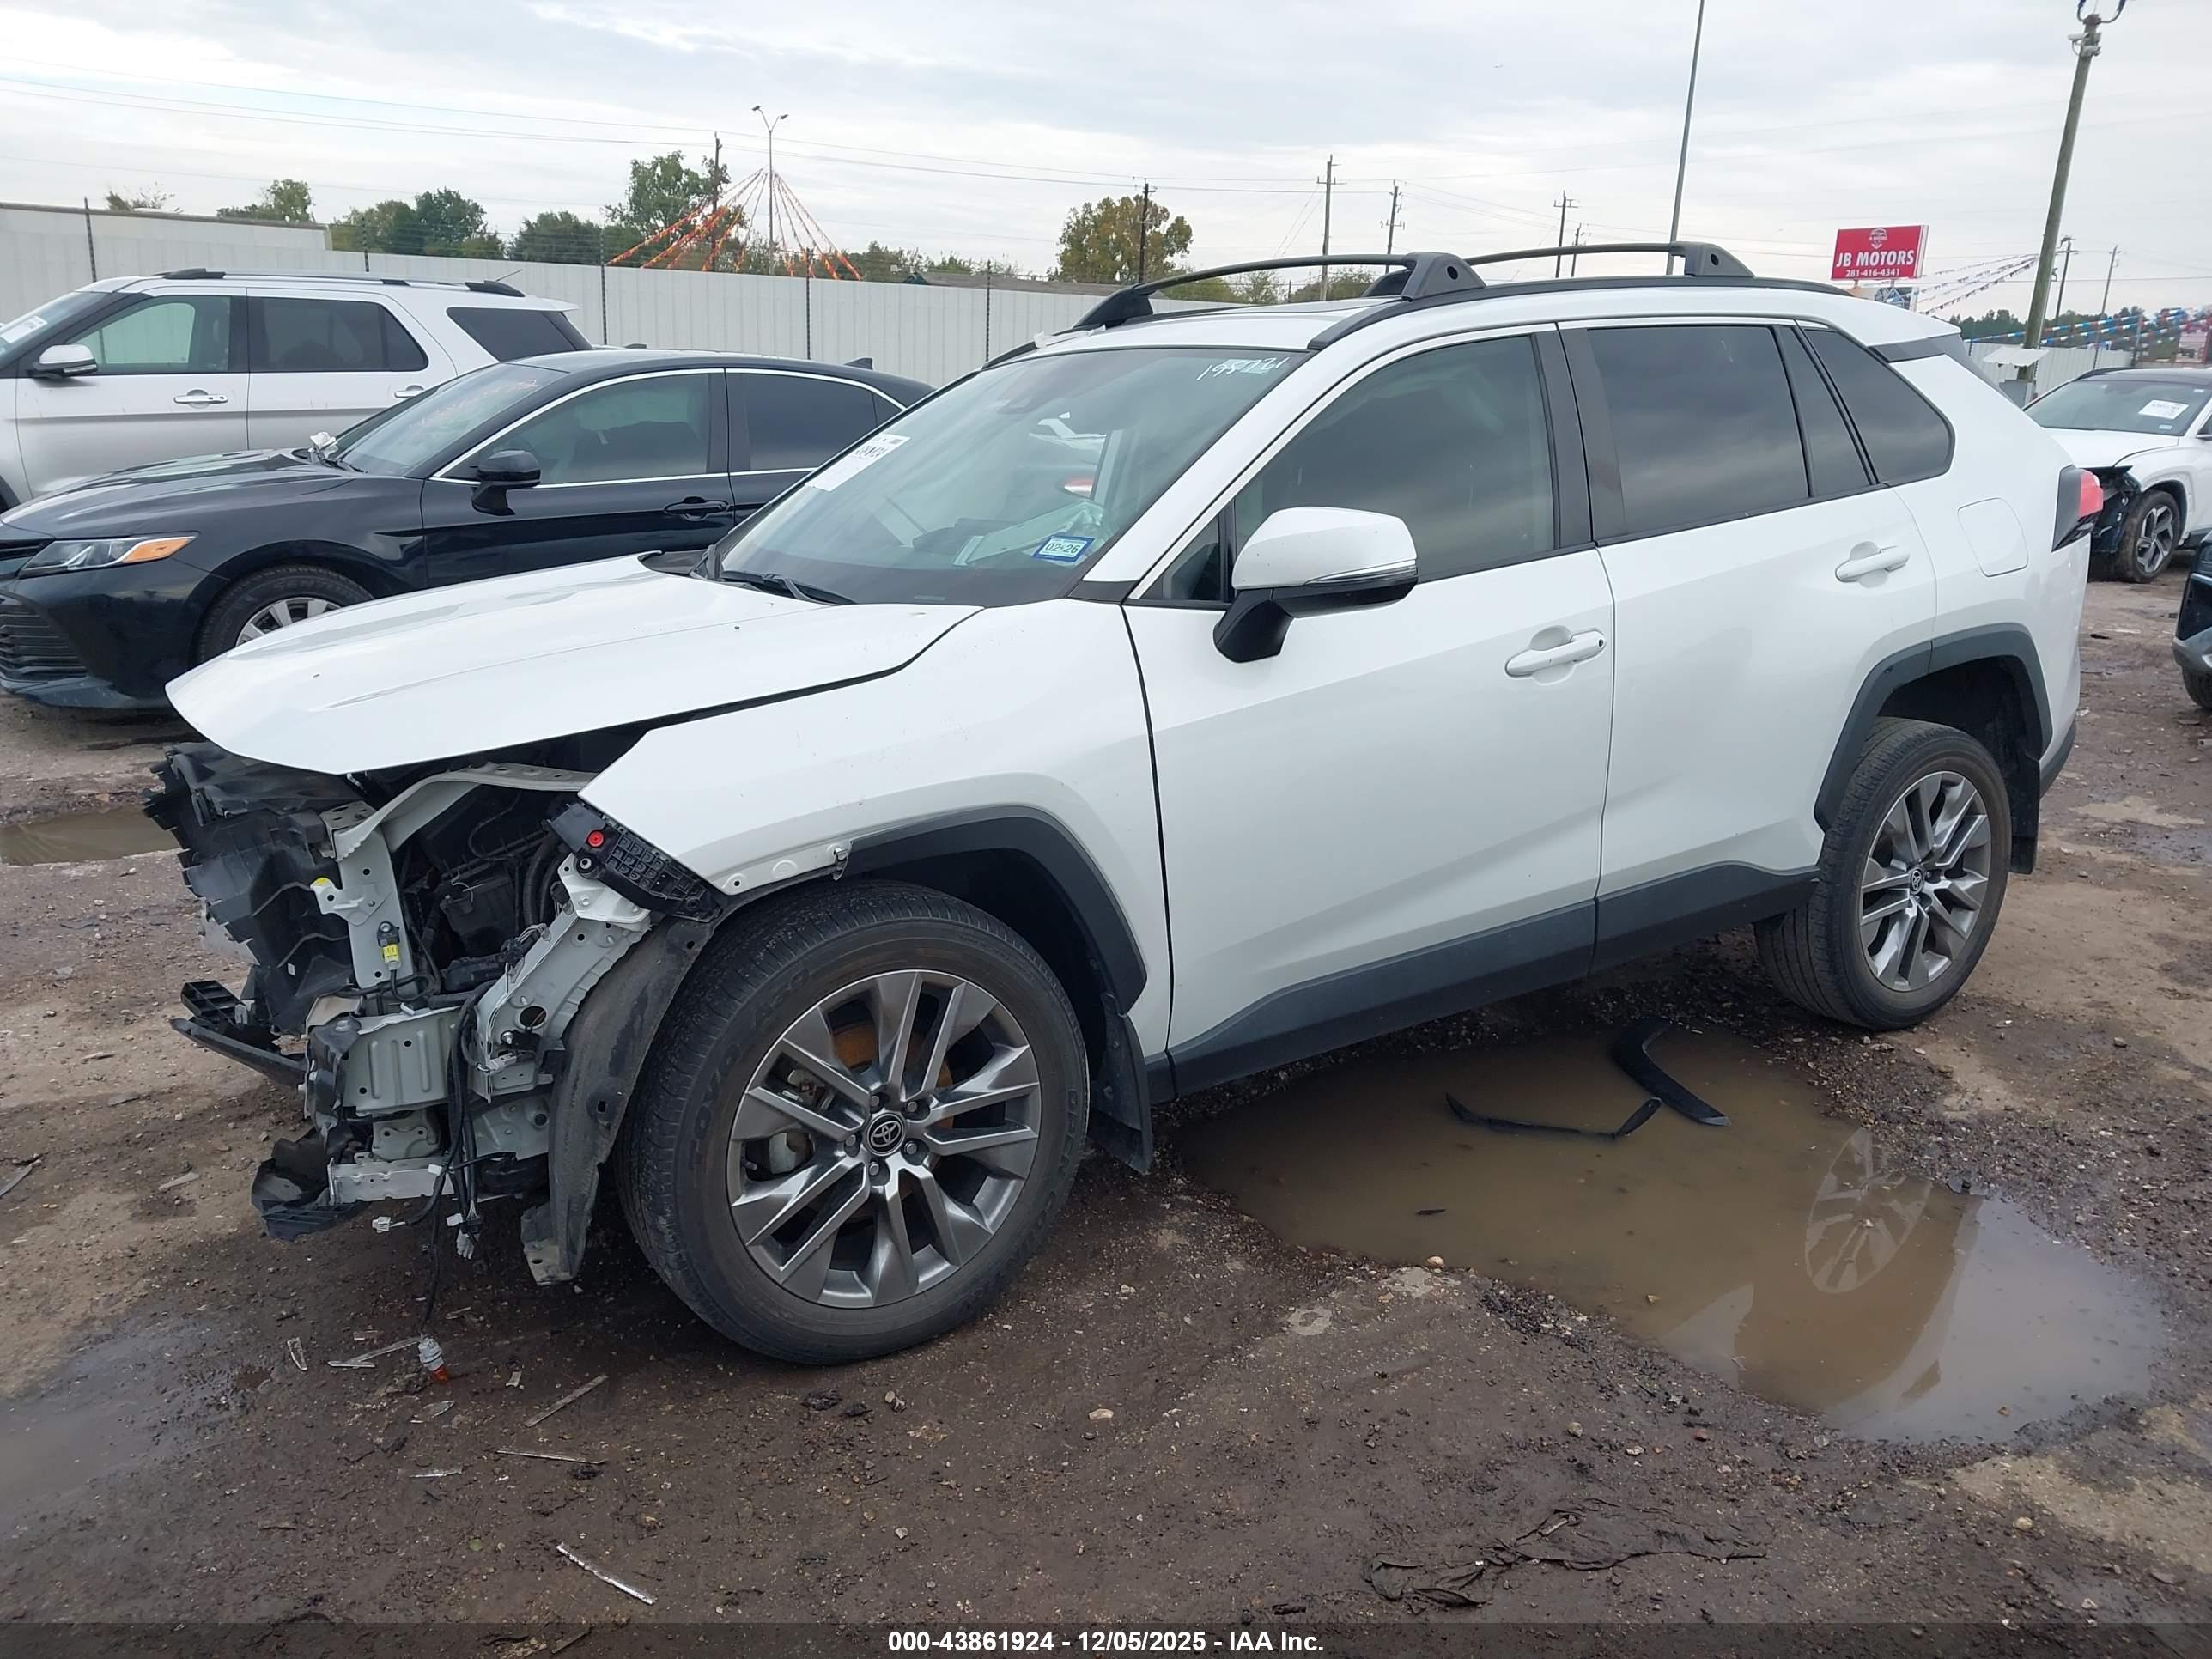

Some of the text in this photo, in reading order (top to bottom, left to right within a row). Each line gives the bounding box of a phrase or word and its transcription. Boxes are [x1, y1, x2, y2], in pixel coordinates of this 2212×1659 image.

[1836, 250, 1914, 267] JB MOTORS
[1845, 268, 1900, 277] 281-416-4341
